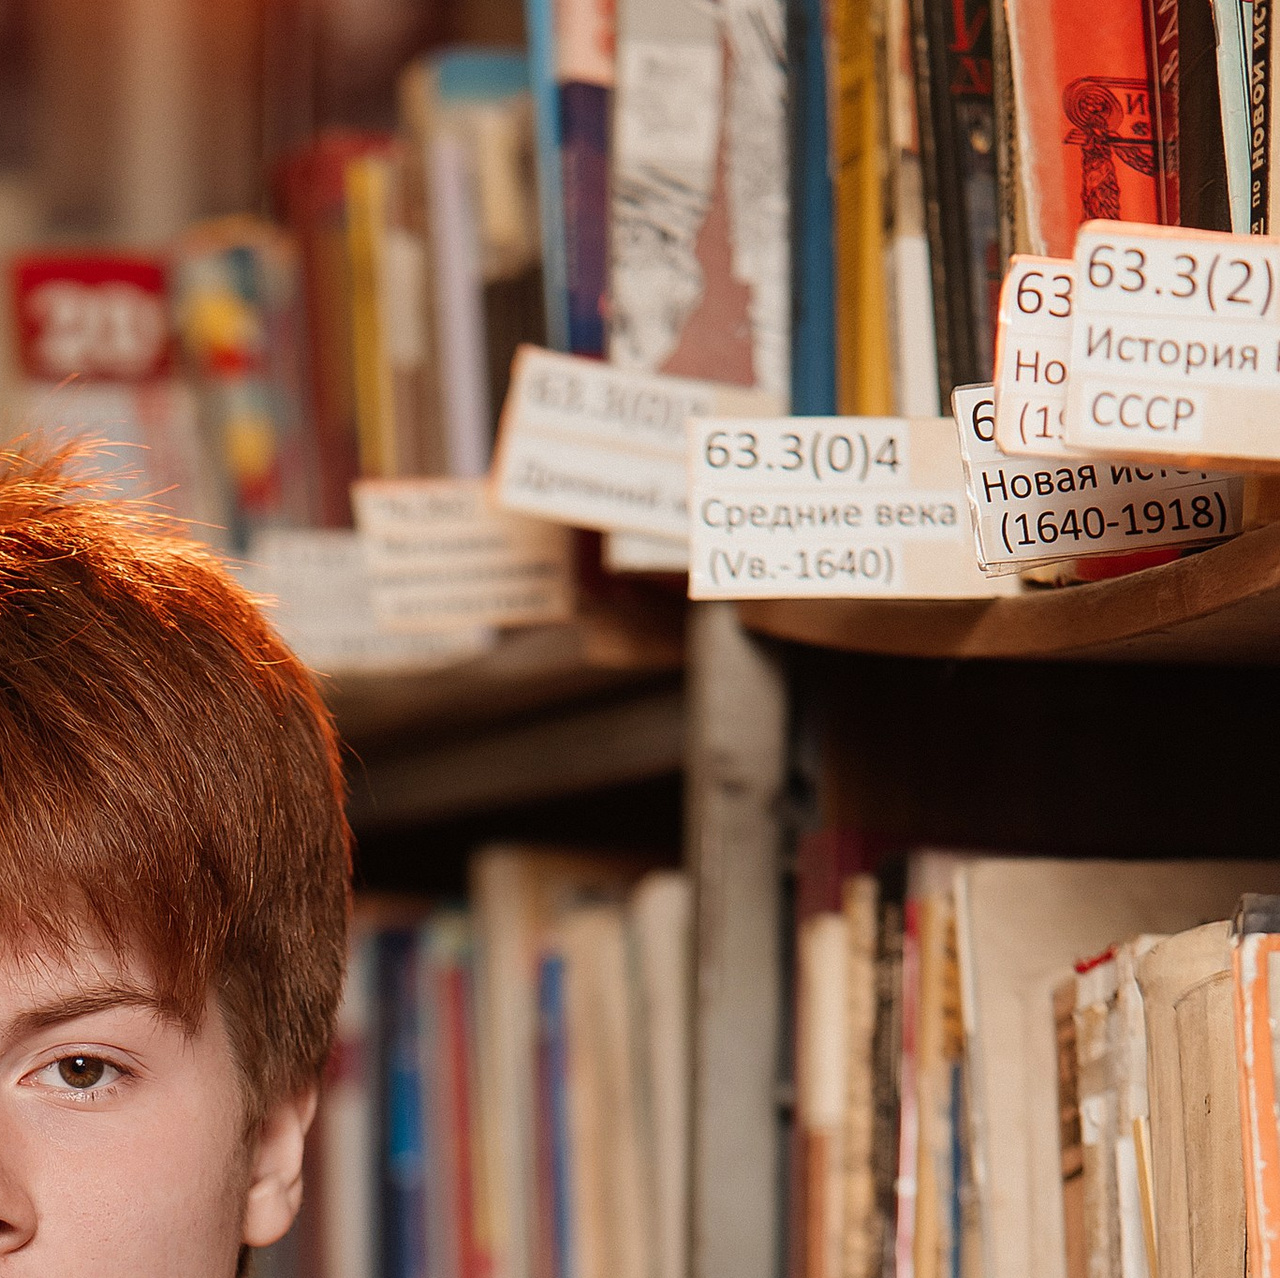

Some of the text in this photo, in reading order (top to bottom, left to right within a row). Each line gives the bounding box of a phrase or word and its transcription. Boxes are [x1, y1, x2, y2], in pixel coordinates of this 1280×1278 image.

[1088, 244, 1274, 316] 63.3(2)
[1087, 325, 1259, 375] История
[1091, 391, 1195, 431] СССР
[705, 430, 900, 481] 63.3(0)4
[982, 464, 1098, 503] Новая
[700, 499, 957, 534] Средние века
[1001, 491, 1227, 554] (1640-1918)
